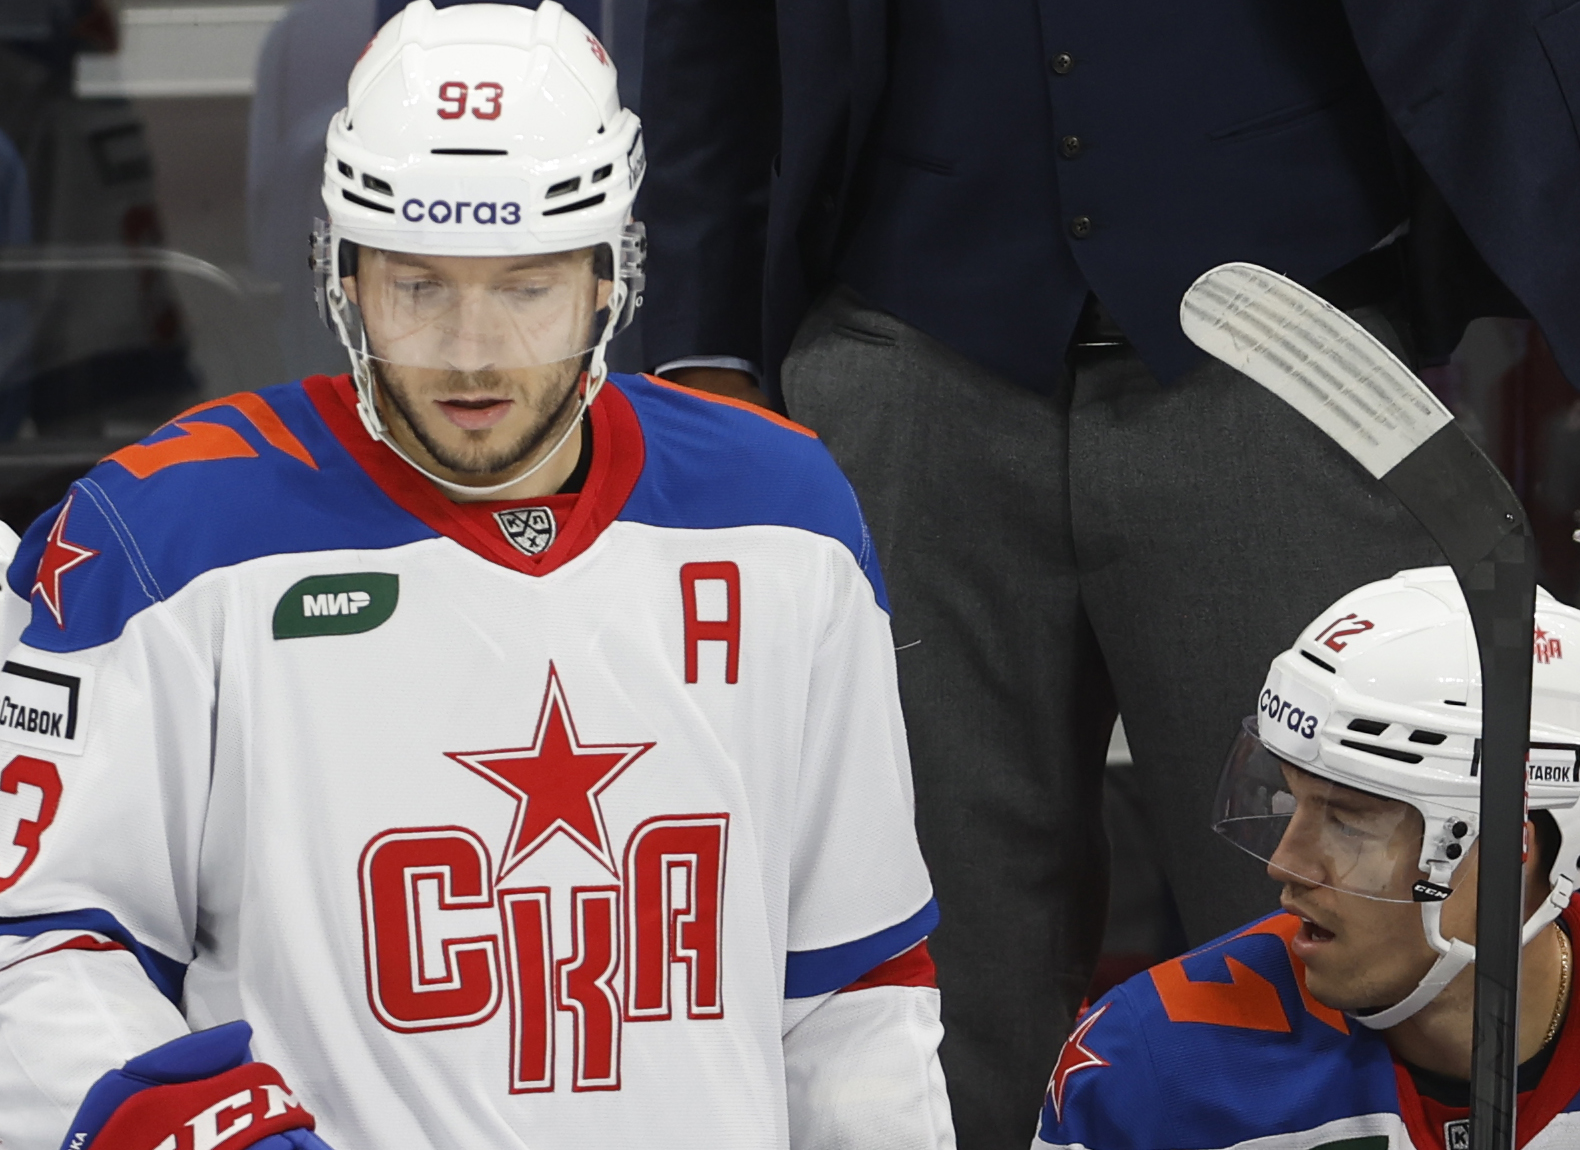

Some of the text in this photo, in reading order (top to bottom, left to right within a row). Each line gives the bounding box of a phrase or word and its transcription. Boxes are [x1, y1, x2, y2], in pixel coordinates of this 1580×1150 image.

[437, 81, 504, 121] 93
[302, 591, 371, 617] МИР
[1314, 613, 1375, 653] 12
[1534, 638, 1563, 665] КА
[1529, 764, 1571, 783] ТАВОК
[358, 812, 730, 1095] СКА
